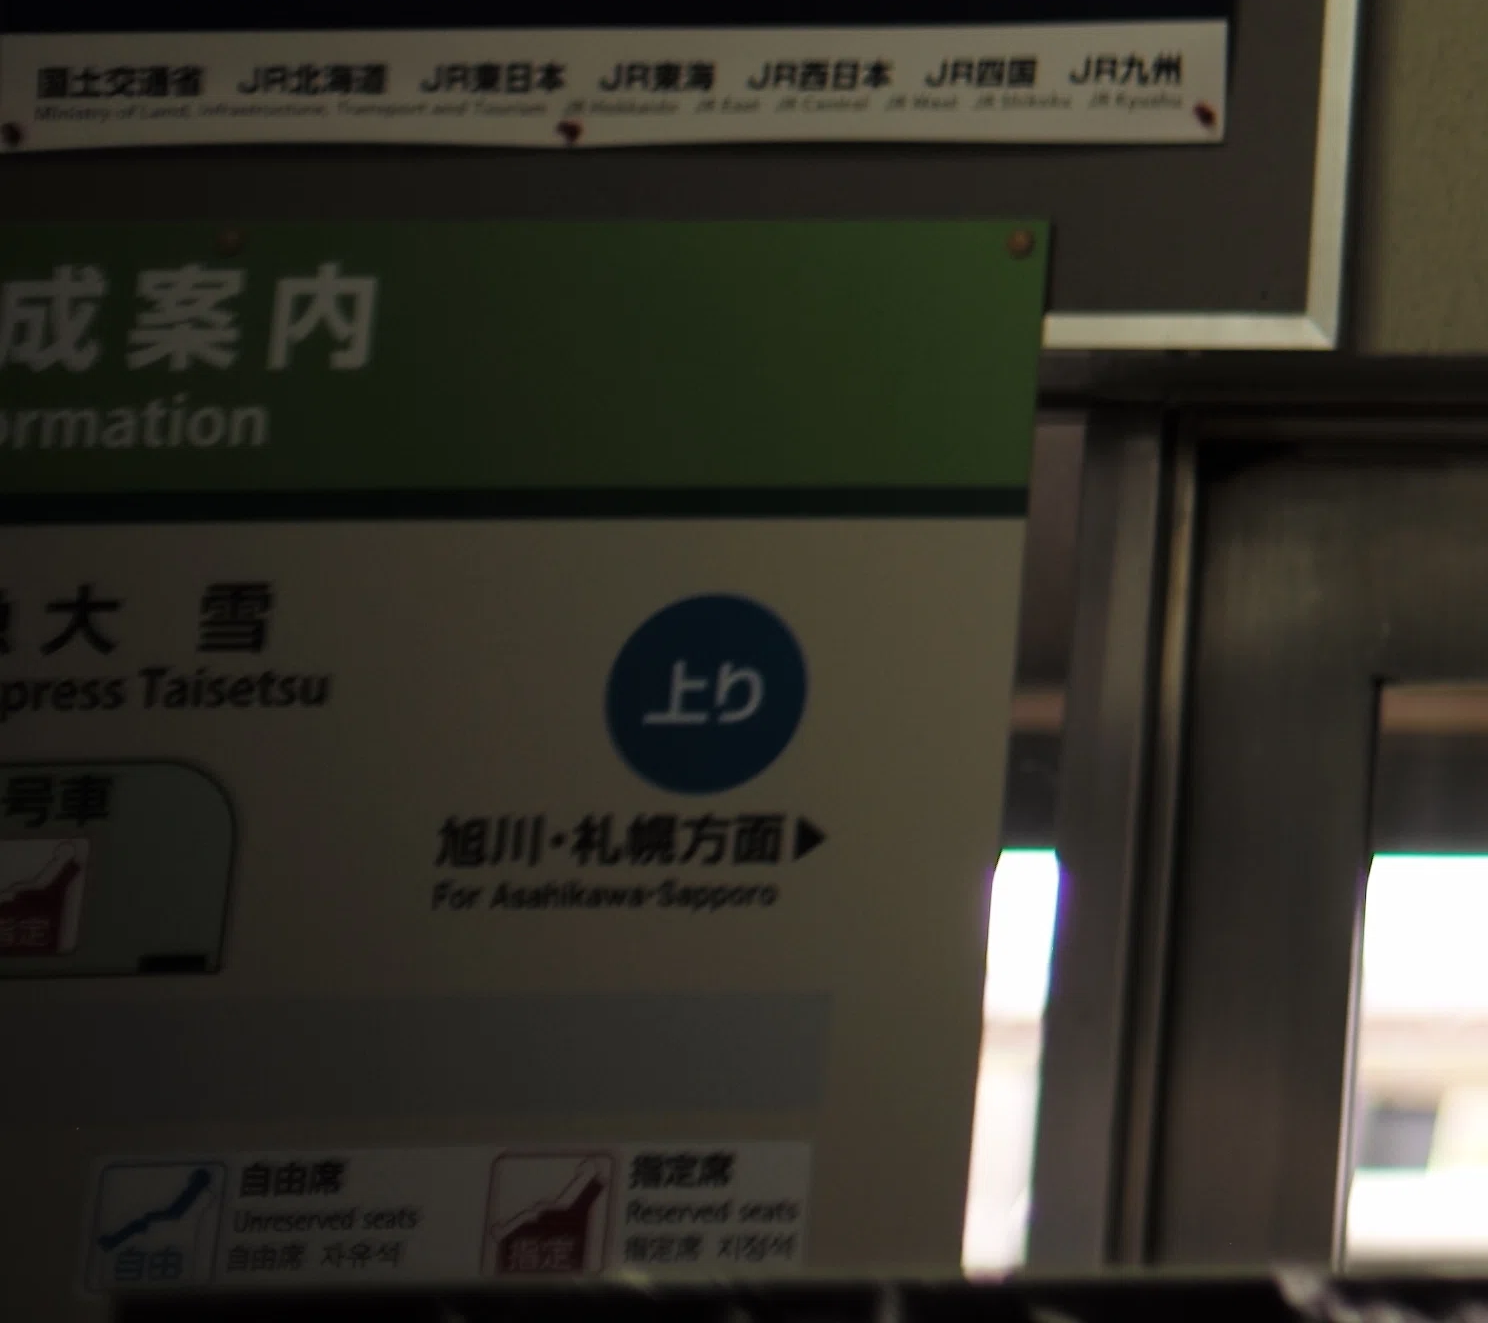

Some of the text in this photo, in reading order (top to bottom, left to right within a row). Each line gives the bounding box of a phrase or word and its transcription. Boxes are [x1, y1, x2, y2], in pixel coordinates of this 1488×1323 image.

[237, 62, 389, 97] JR北海道
[420, 61, 568, 95] JR東日本
[746, 59, 896, 92] JR西日本
[925, 56, 1039, 90] JR四国
[1069, 54, 1183, 89] JR九州
[138, 664, 332, 710] Taisetsu
[642, 659, 764, 726] 上り
[435, 813, 785, 868] 旭川・札幌方面
[431, 879, 483, 911] For
[237, 1160, 345, 1200] 自由席
[628, 1154, 733, 1191] 指定席
[231, 1206, 422, 1235] Unreserved seats
[624, 1198, 799, 1226] Reserved seats
[113, 1246, 185, 1283] 自由
